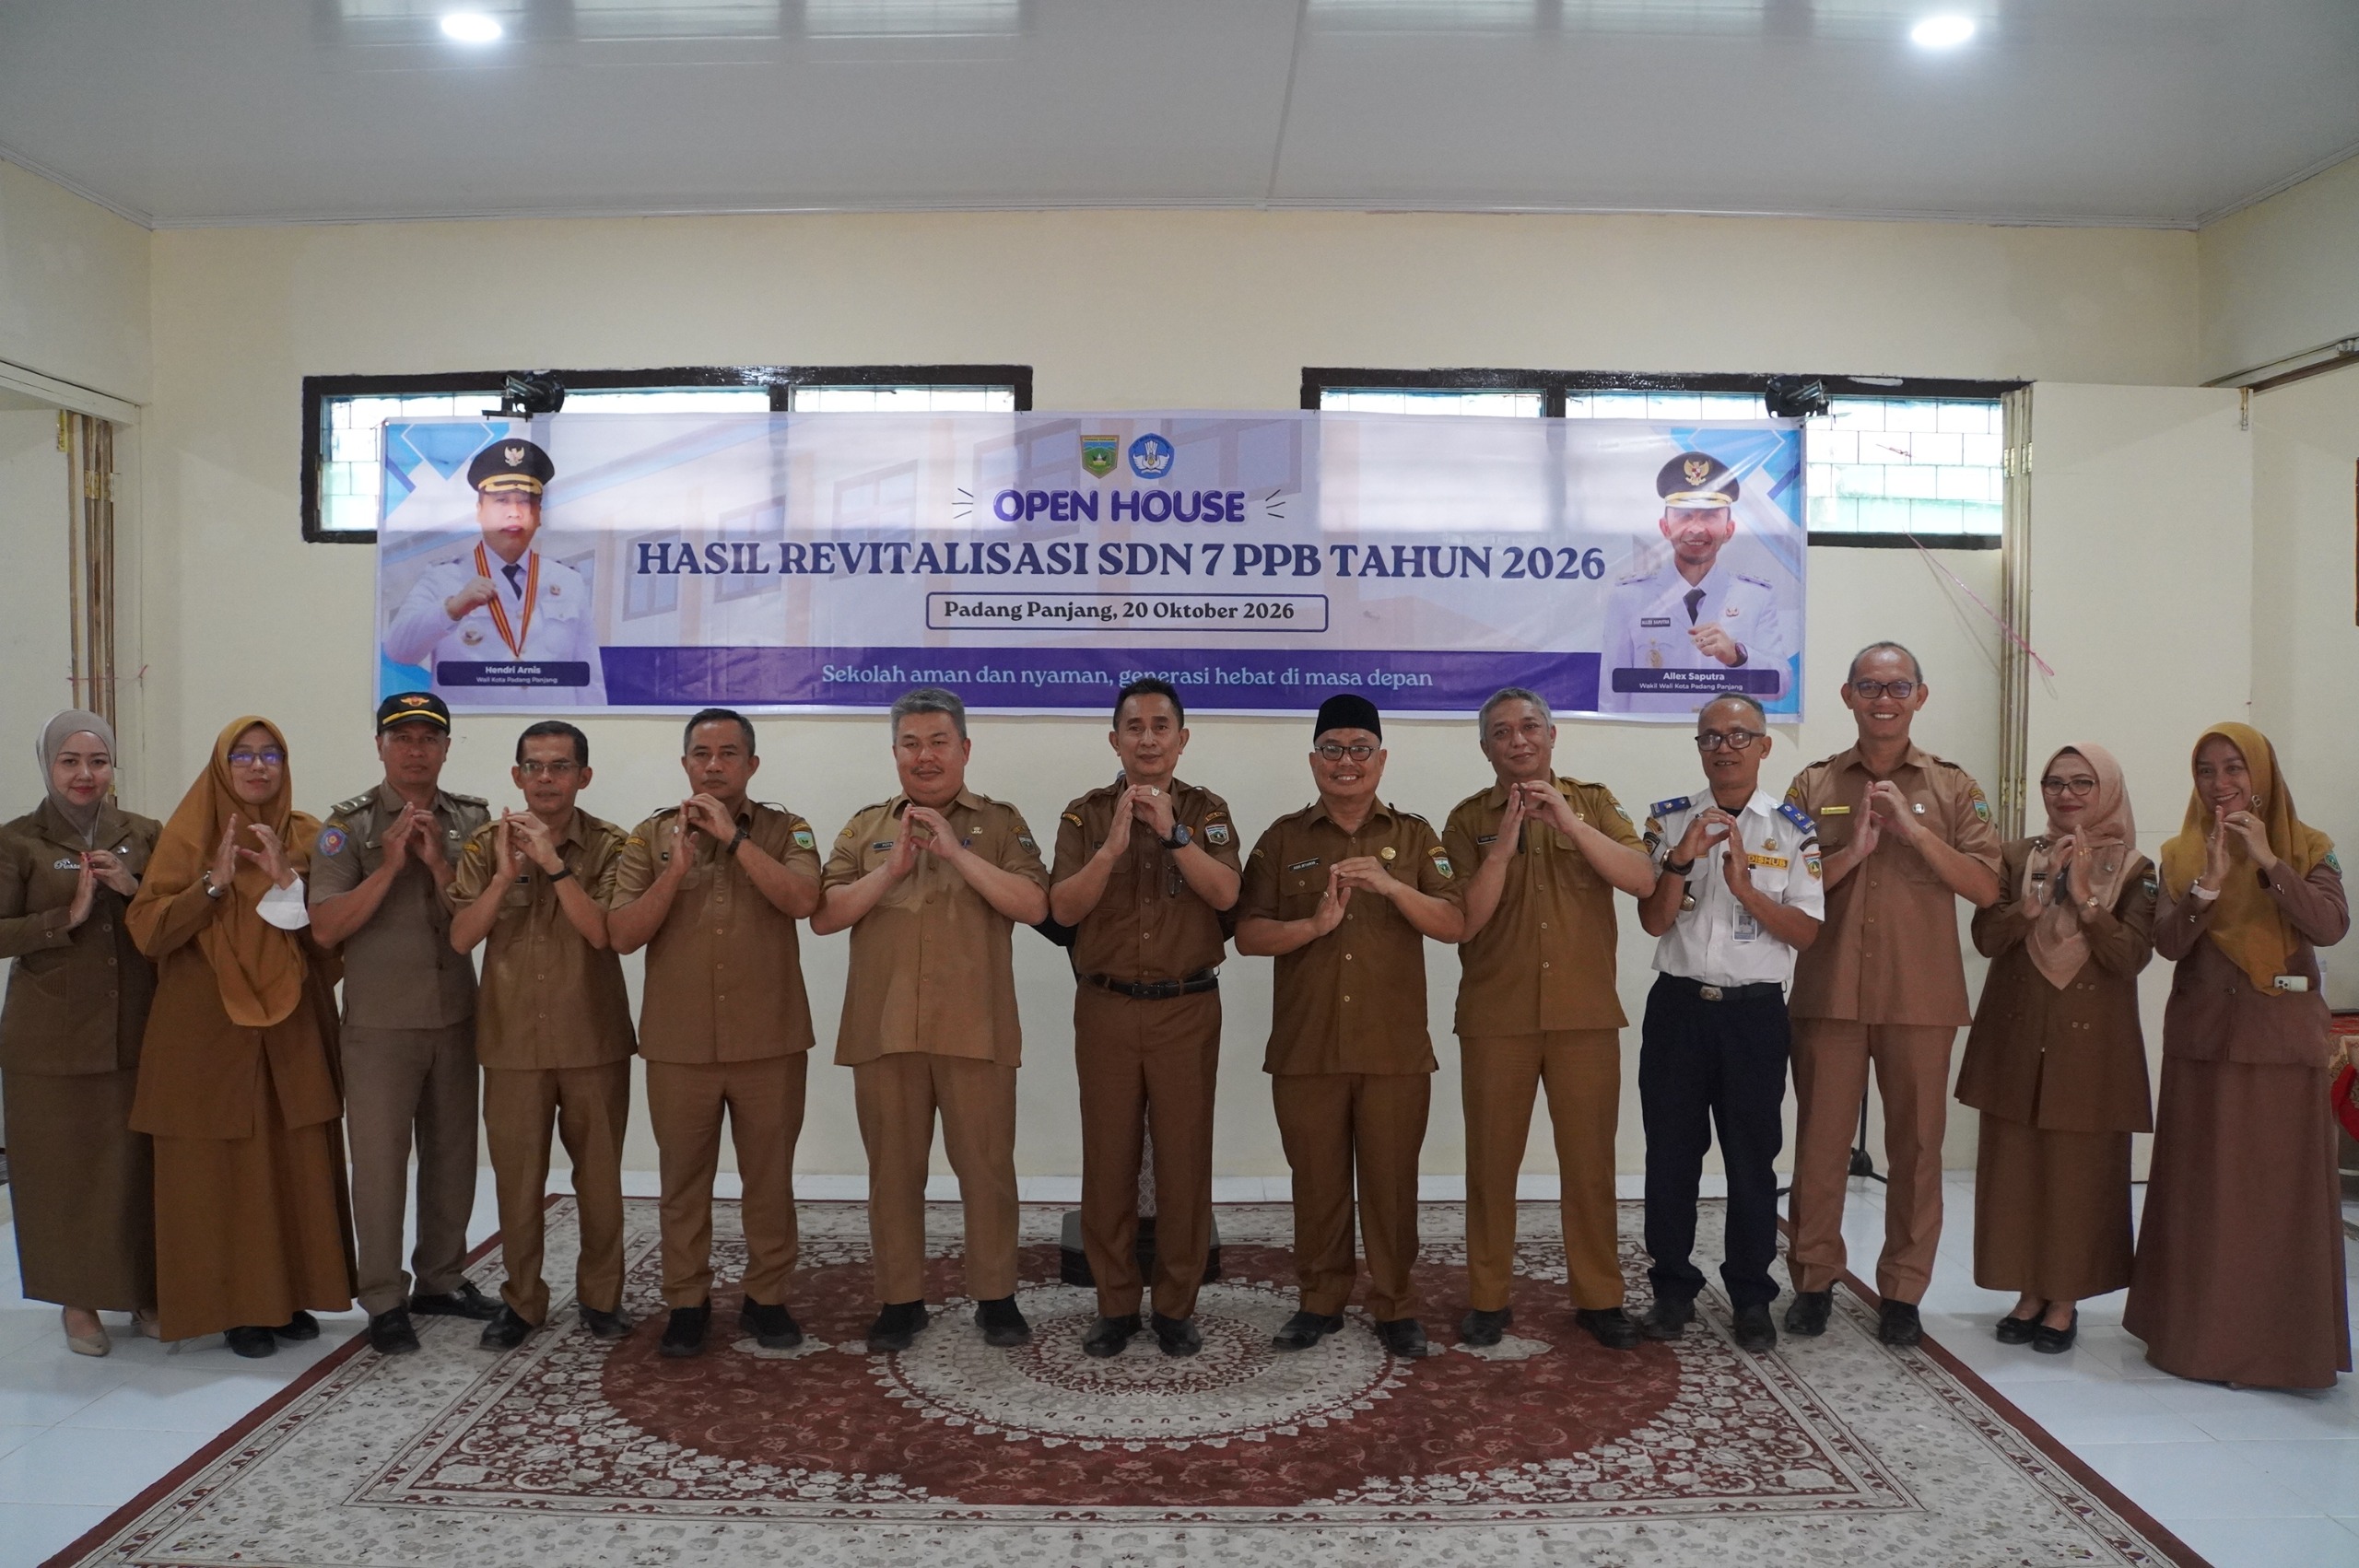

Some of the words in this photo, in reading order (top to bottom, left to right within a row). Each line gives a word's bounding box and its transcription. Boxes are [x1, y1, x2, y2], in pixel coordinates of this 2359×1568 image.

[993, 489, 1098, 522] OPEN
[1110, 489, 1245, 523] HOUSE
[638, 542, 770, 576] HASIL
[778, 542, 1089, 576] REVITALISASI
[1097, 542, 1193, 577] SDN
[1201, 543, 1226, 577] 7
[1232, 544, 1321, 578] PPB
[1329, 544, 1493, 579] TAHUN
[1502, 546, 1605, 580] 2026
[945, 601, 1023, 621] Padang
[1027, 601, 1118, 622] Panjang,
[1122, 602, 1149, 618] 20
[1153, 602, 1238, 619] Oktober
[1243, 603, 1295, 619] 2026
[485, 665, 516, 674] Hendri
[517, 665, 541, 674] Arnis
[507, 676, 531, 685] Padang
[532, 676, 558, 685] Panjang
[822, 664, 906, 683] Sekolah
[910, 670, 971, 683] aman
[976, 666, 1015, 683] dan
[1021, 671, 1113, 687] nyaman,
[1215, 667, 1275, 685] hebat
[1281, 668, 1299, 685] di
[1306, 673, 1362, 685] masa
[1367, 668, 1433, 690] depan
[1662, 672, 1686, 681] Allex
[1688, 672, 1725, 683] Saputra
[1639, 682, 1658, 690] Wakil
[1659, 682, 1673, 690] Wali
[1690, 683, 1715, 692] Padang
[1717, 683, 1743, 692] Panjang
[1747, 855, 1787, 867] DISHUB
